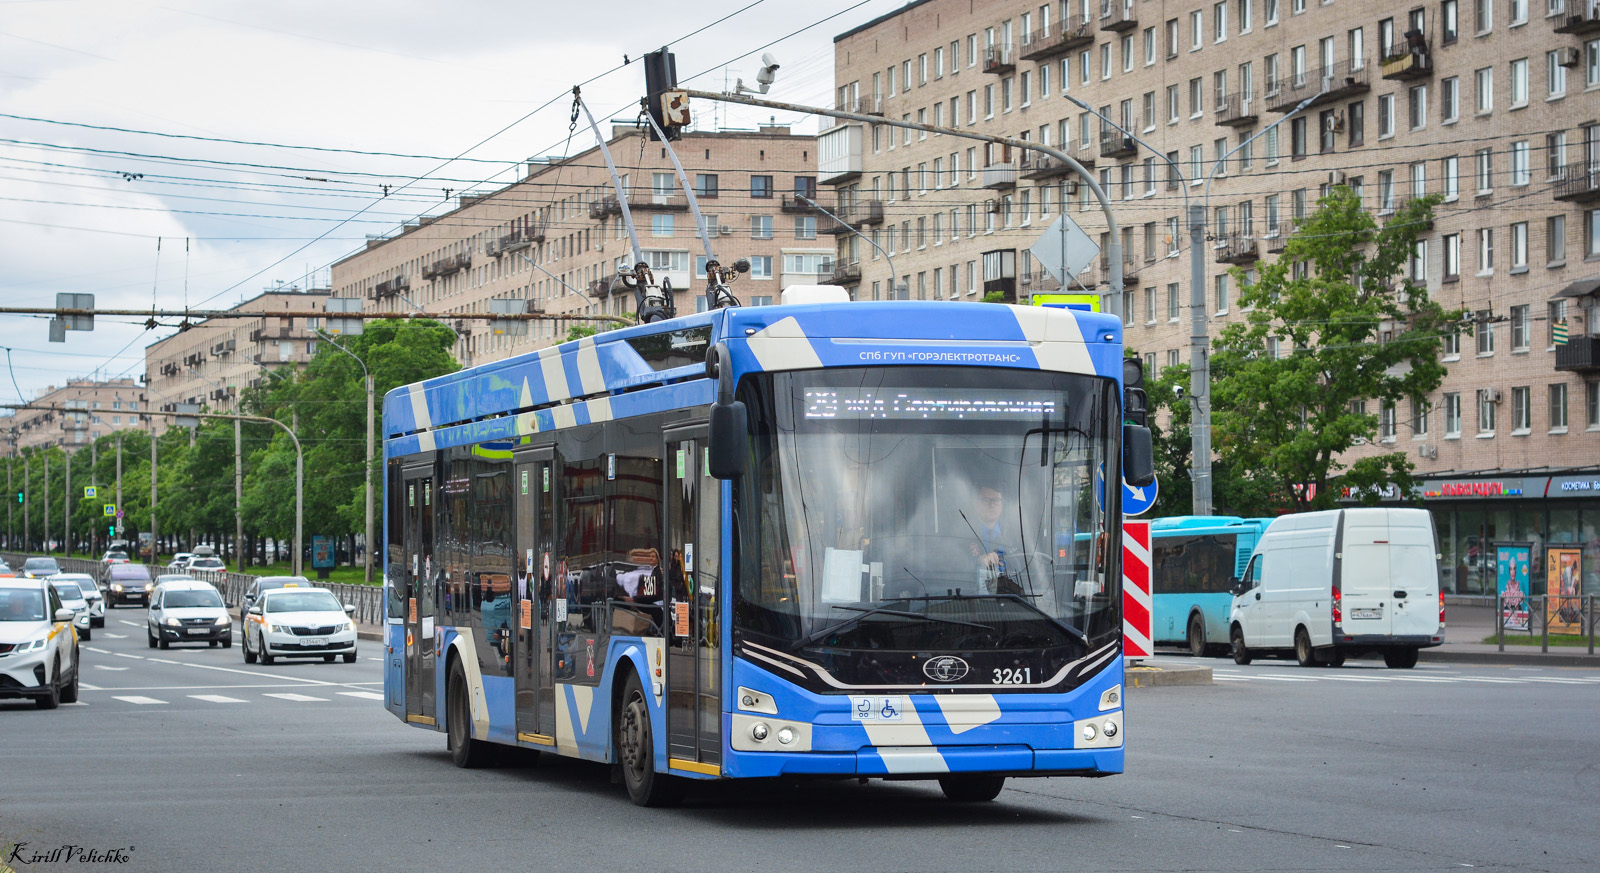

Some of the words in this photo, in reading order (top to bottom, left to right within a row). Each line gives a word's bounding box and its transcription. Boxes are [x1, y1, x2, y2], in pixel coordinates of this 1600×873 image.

[859, 351, 881, 360] СПб
[884, 352, 905, 360] ГУП
[908, 352, 1020, 362] «ГОРЭЛЕКТРОТРАНС»
[1561, 480, 1591, 491] КОСМЕТИКА
[643, 576, 656, 596] 3261
[992, 668, 1030, 684] 3261
